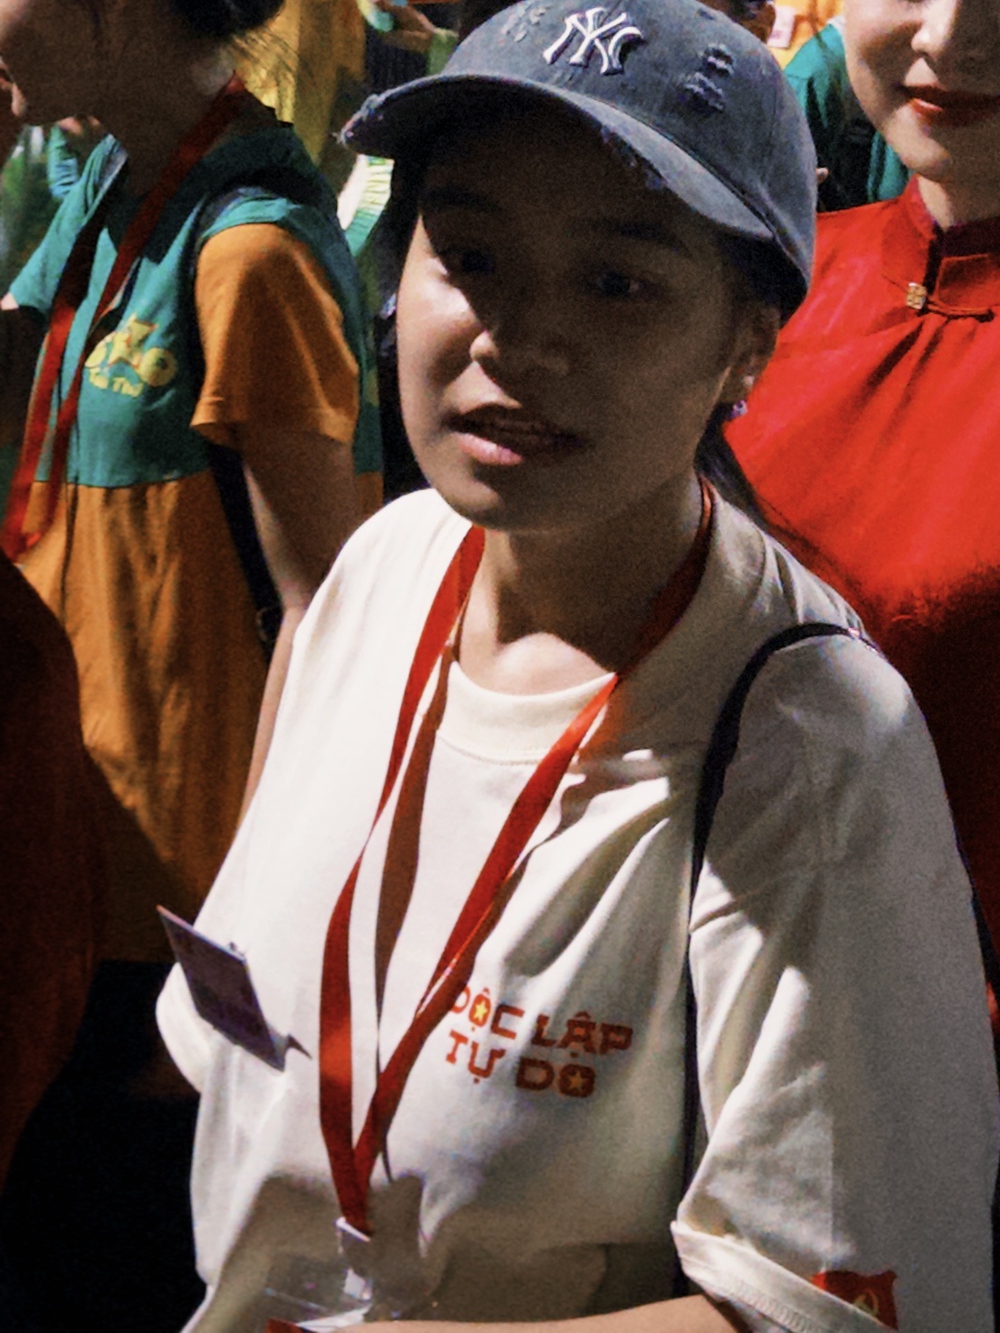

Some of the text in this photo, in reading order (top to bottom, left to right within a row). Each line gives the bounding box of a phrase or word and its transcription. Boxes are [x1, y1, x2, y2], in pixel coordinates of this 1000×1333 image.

[542, 7, 643, 76] NY
[446, 1030, 596, 1098] TỰ DO
[531, 1011, 634, 1058] LẬP
